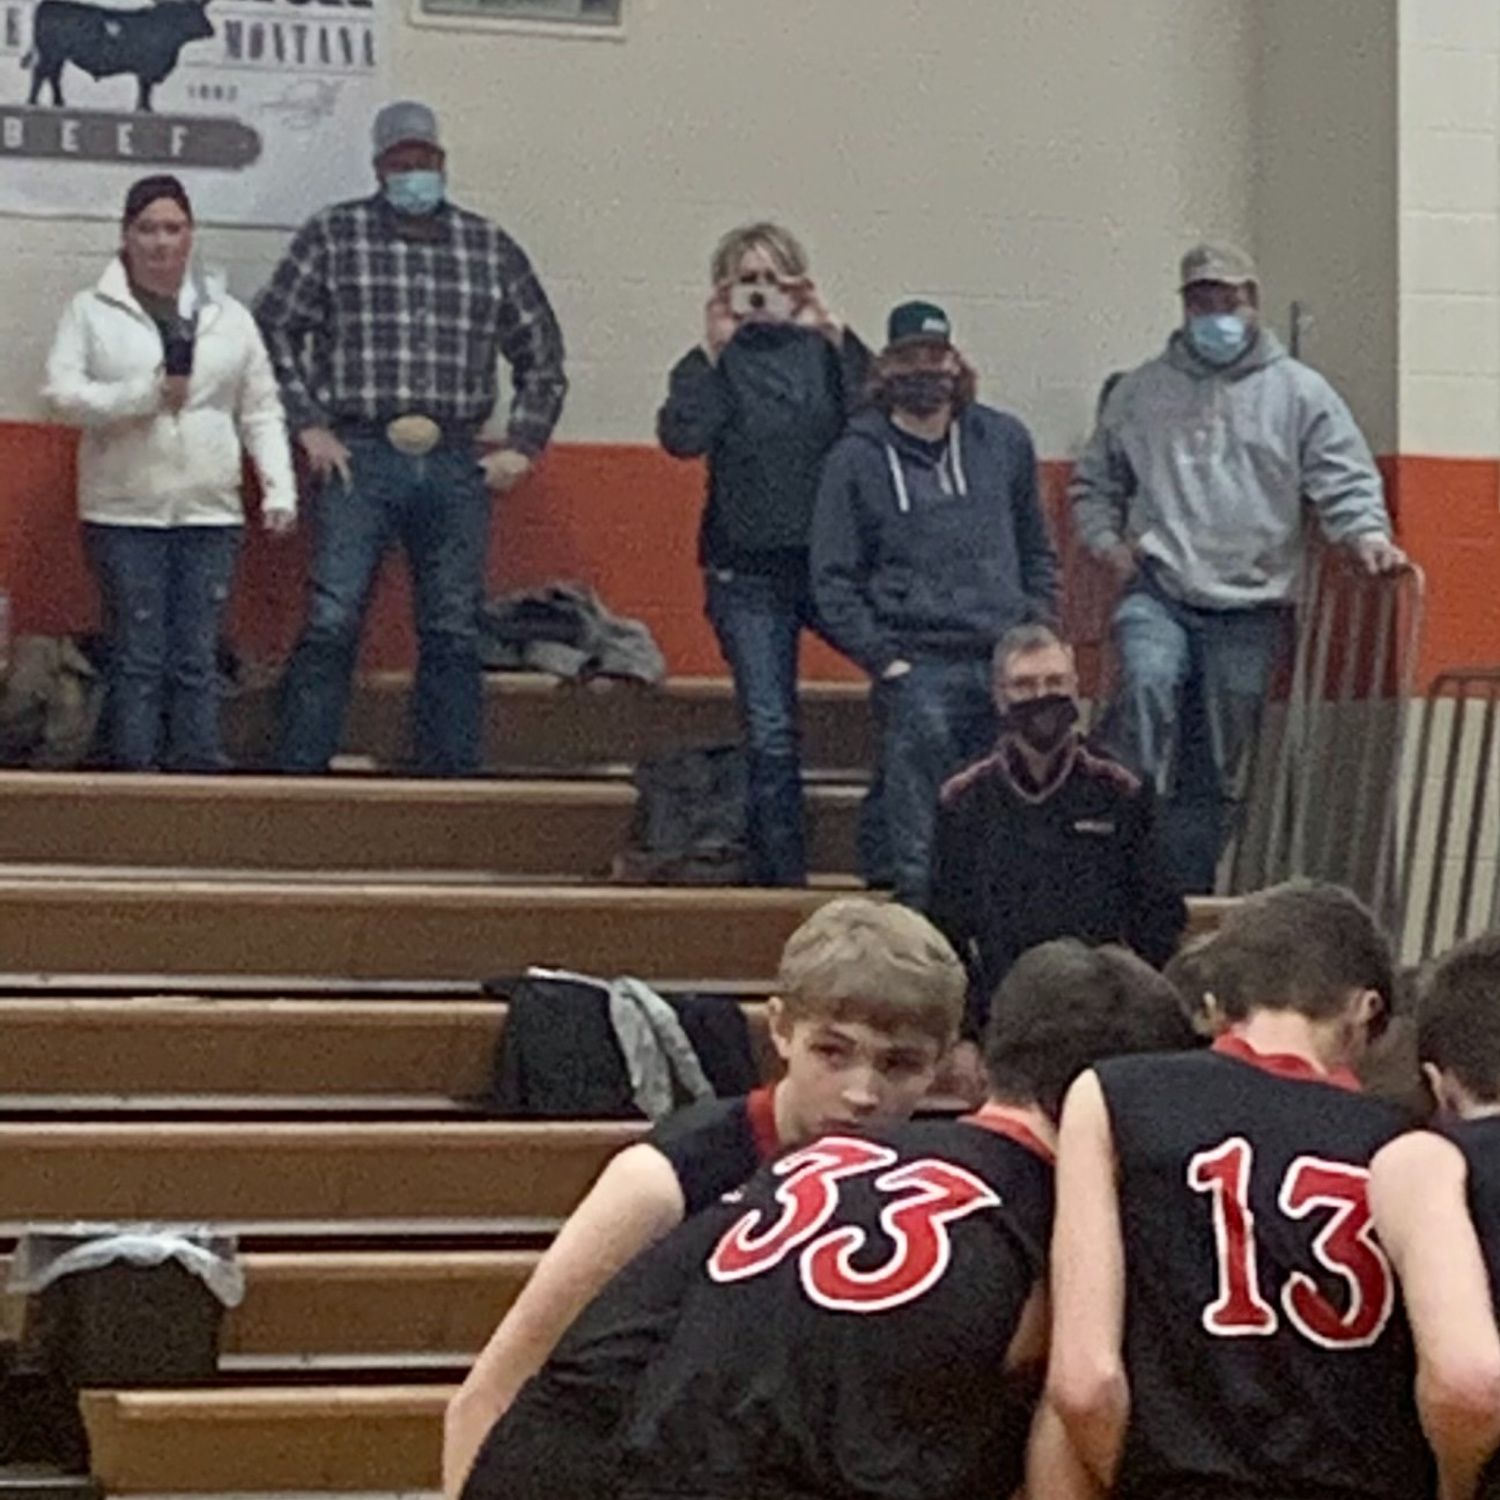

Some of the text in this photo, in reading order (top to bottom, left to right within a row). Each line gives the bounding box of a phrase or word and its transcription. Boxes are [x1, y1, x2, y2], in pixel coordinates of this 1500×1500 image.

[2, 115, 189, 156] BEEF
[708, 1136, 1000, 1312] 33
[1189, 1137, 1394, 1349] 13
